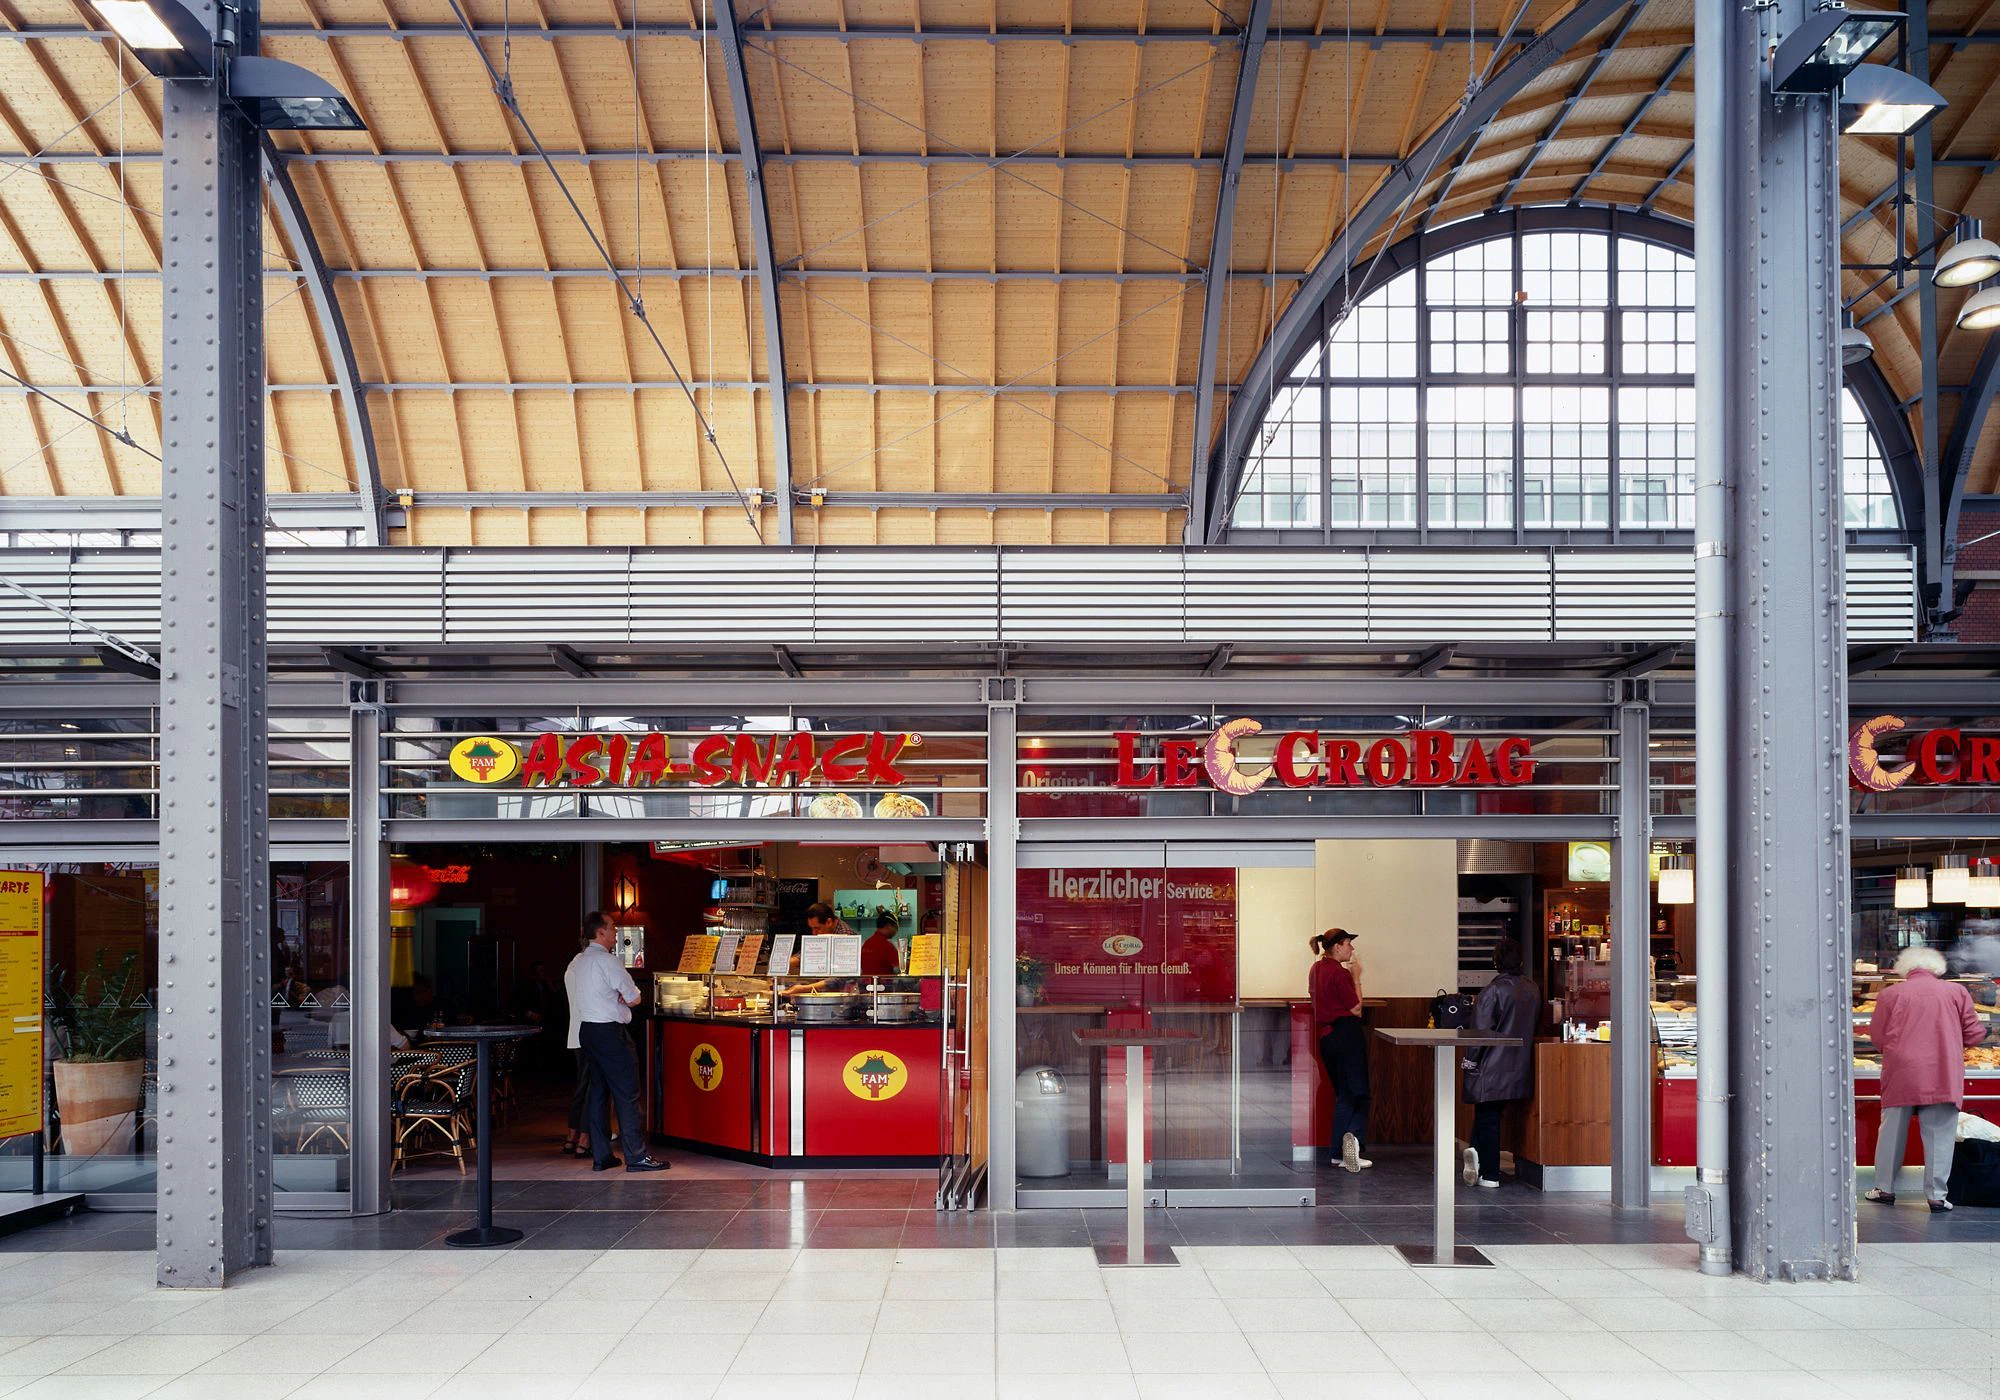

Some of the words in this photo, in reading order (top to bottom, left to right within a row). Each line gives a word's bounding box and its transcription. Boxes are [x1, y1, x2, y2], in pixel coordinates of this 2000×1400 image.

[471, 758, 494, 767] FAM
[1022, 770, 1095, 799] Original
[0, 880, 30, 894] ARTE
[1048, 868, 1164, 899] Herzlicher
[1166, 882, 1213, 899] Service
[1054, 962, 1081, 975] Unser
[1083, 962, 1117, 975] Können
[1119, 962, 1132, 975] für
[1135, 962, 1158, 975] Ihren
[1160, 962, 1192, 975] Genuß.
[699, 1065, 713, 1076] FAM
[862, 1073, 887, 1084] FAM
